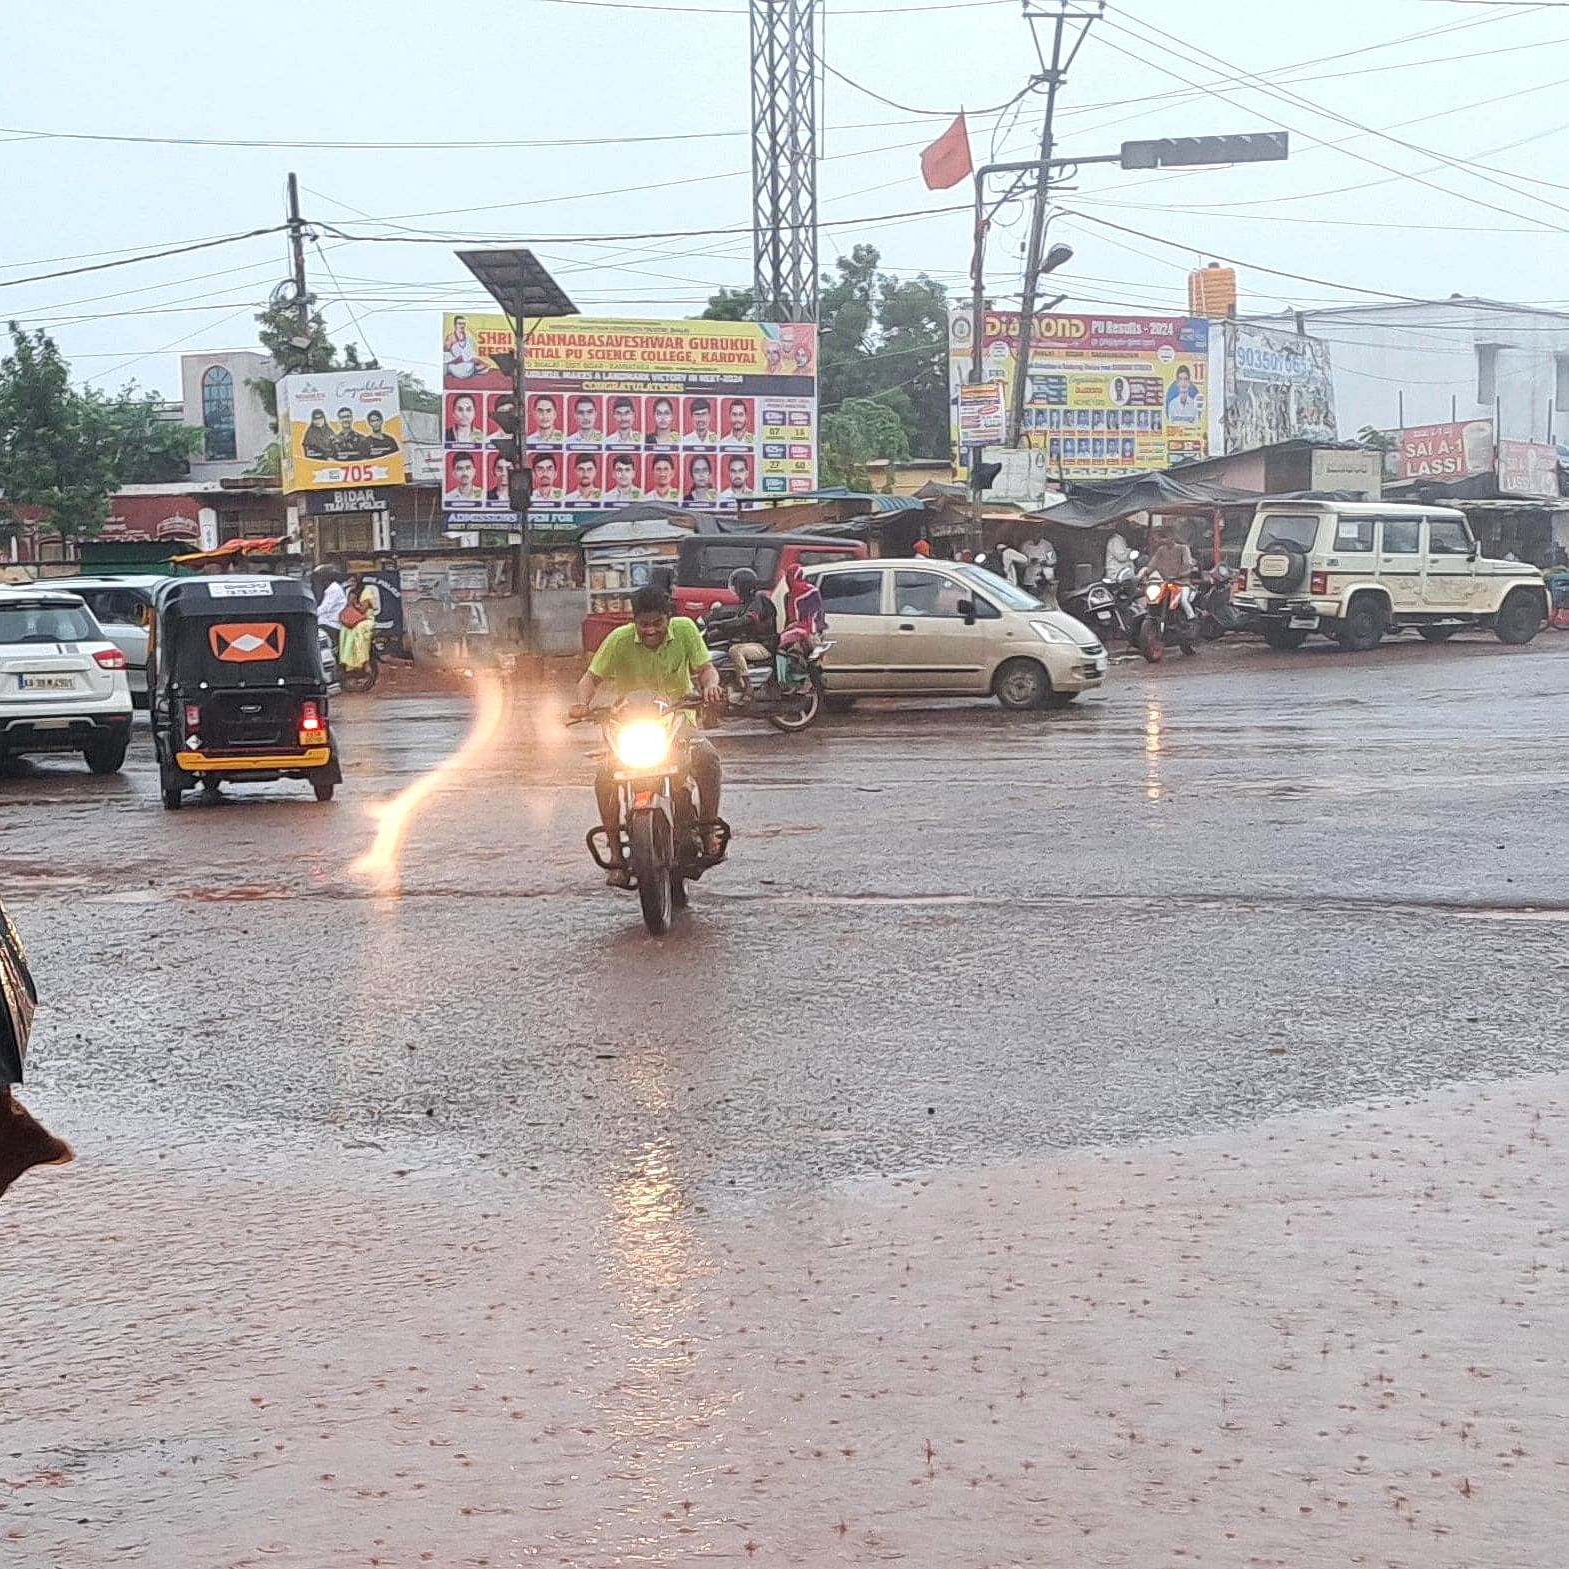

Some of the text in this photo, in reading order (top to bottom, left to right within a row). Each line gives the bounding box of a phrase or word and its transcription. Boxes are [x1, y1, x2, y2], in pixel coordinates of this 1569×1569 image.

[1091, 319, 1105, 334] PU
[1150, 322, 1174, 336] 2024
[478, 331, 513, 345] SHRI
[522, 333, 684, 350] HANNABASAVESHWAR
[689, 337, 758, 351] GURUKUL
[565, 349, 582, 360] PU
[587, 350, 637, 361] SCIENCE
[640, 351, 697, 364] COLLEGE,
[701, 353, 758, 364] KARDYAL
[582, 380, 685, 392] CONGRATULATIONS
[1406, 439, 1463, 458] SAI A-1
[340, 465, 374, 482] 705
[1406, 457, 1463, 478] LASSI
[334, 489, 376, 503] BIDAR
[358, 499, 387, 511] POLICE
[447, 512, 574, 523] ADMISSIONS PEN FOR
